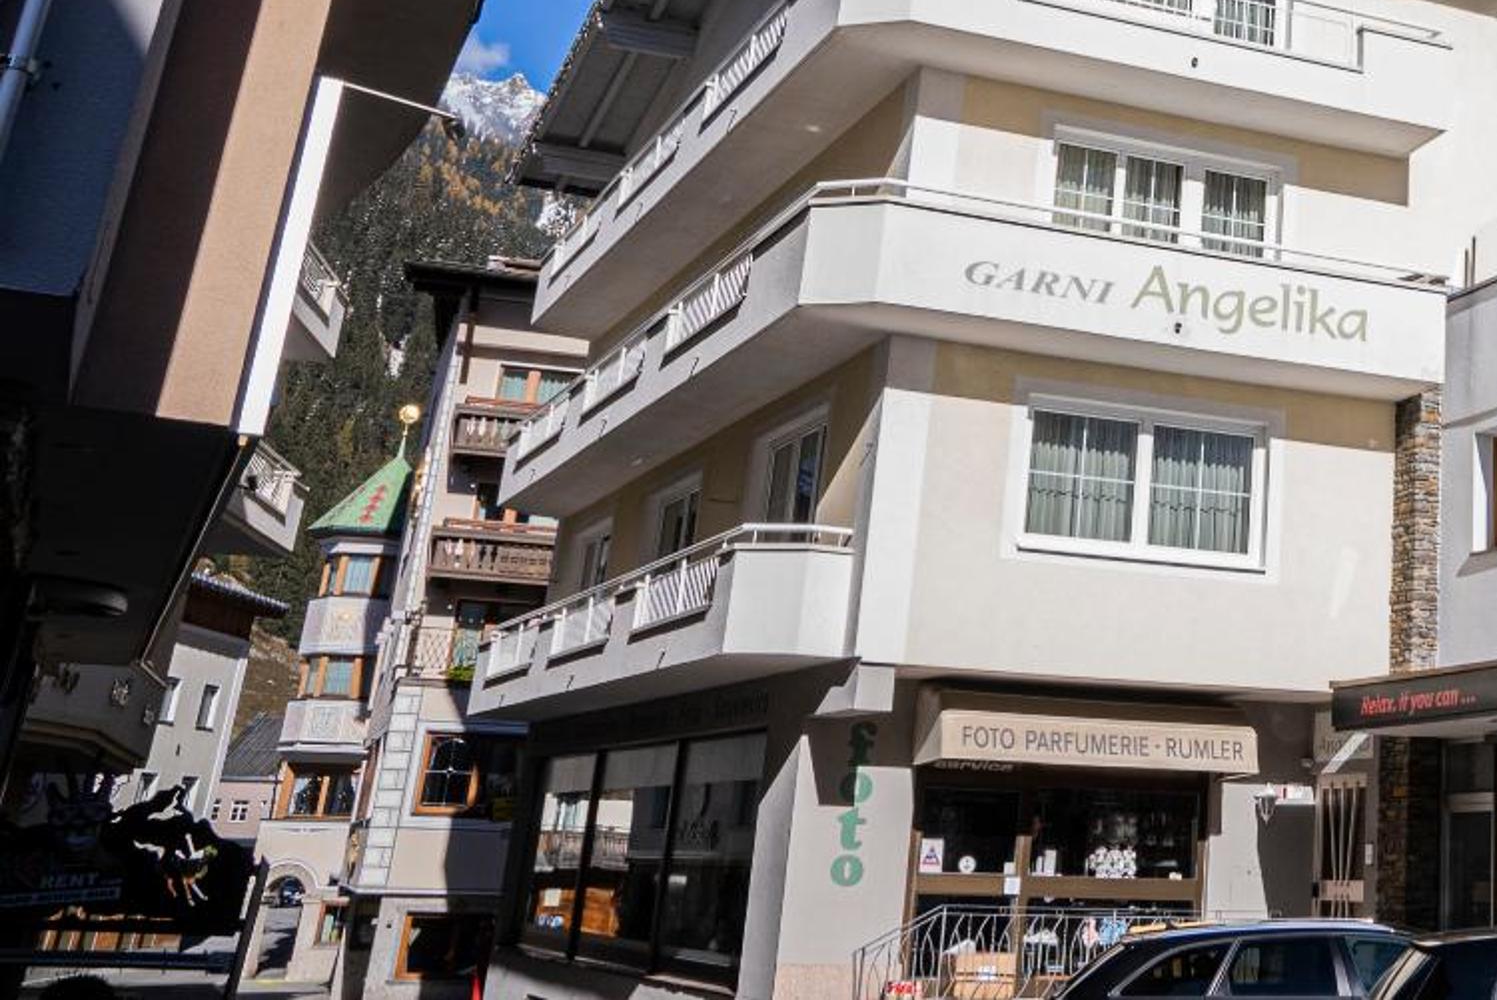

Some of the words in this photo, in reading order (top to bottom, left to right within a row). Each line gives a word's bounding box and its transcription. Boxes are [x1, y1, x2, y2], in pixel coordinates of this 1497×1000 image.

[964, 260, 1116, 305] GARNI
[1131, 264, 1369, 342] Angelika
[1410, 692, 1434, 716] you
[961, 726, 1015, 749] FOTO
[1025, 729, 1150, 757] PARFUMERIE
[1165, 737, 1244, 760] RUMLER
[830, 720, 878, 887] foto
